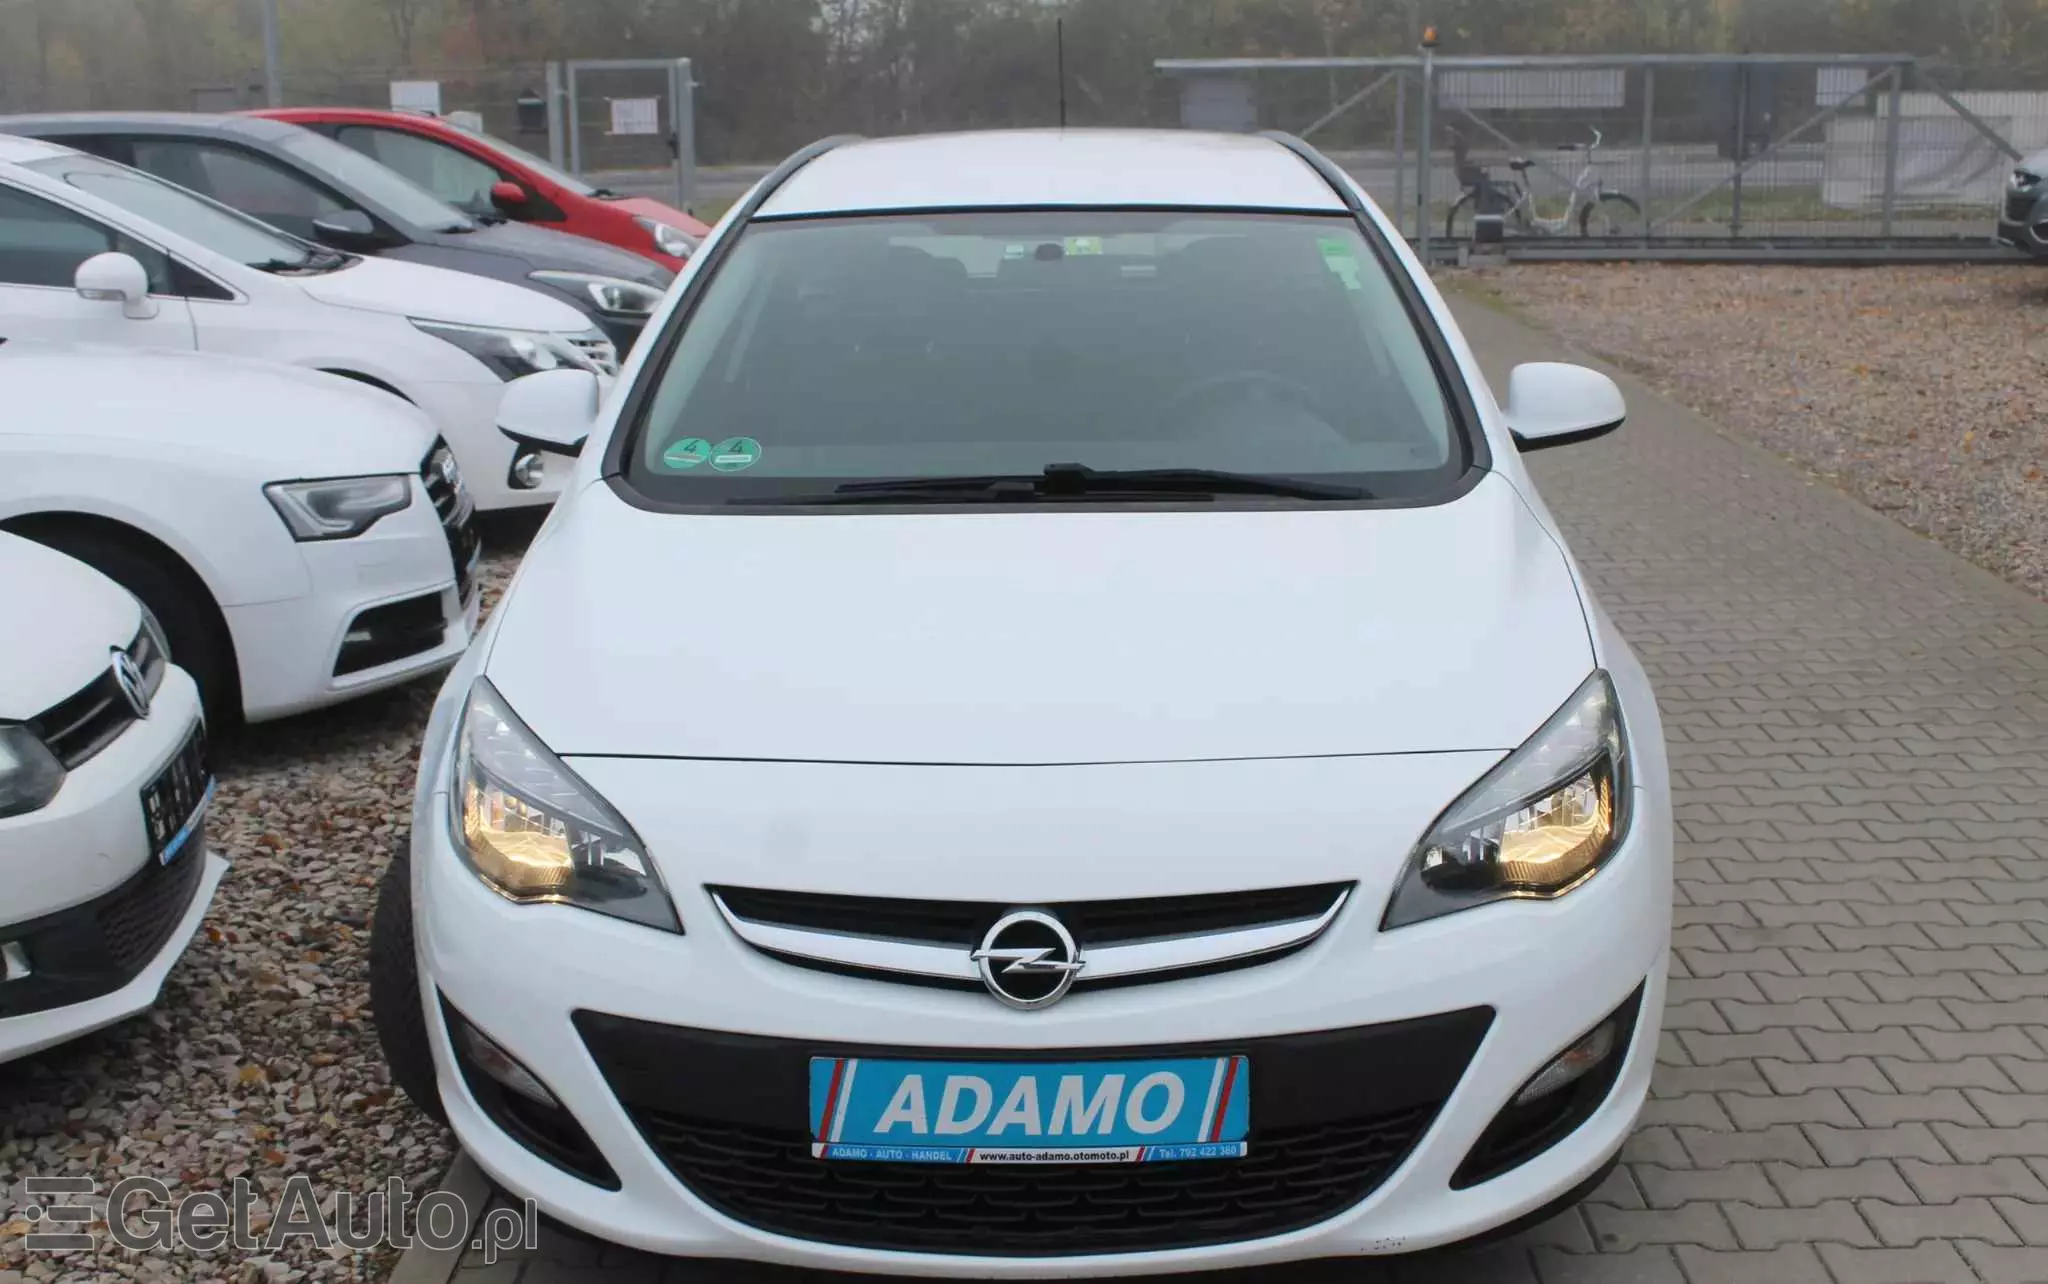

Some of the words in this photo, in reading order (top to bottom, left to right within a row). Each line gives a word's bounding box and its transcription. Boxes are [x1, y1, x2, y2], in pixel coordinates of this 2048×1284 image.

[683, 439, 698, 453] 4
[728, 440, 743, 453] 4
[872, 1071, 1185, 1136] ADAMO
[832, 1148, 868, 1159] ADAMO
[876, 1149, 901, 1160] AUTO
[911, 1150, 952, 1161] HANDEL
[979, 1149, 1130, 1162] www.auto-adamo.otomoto.pl
